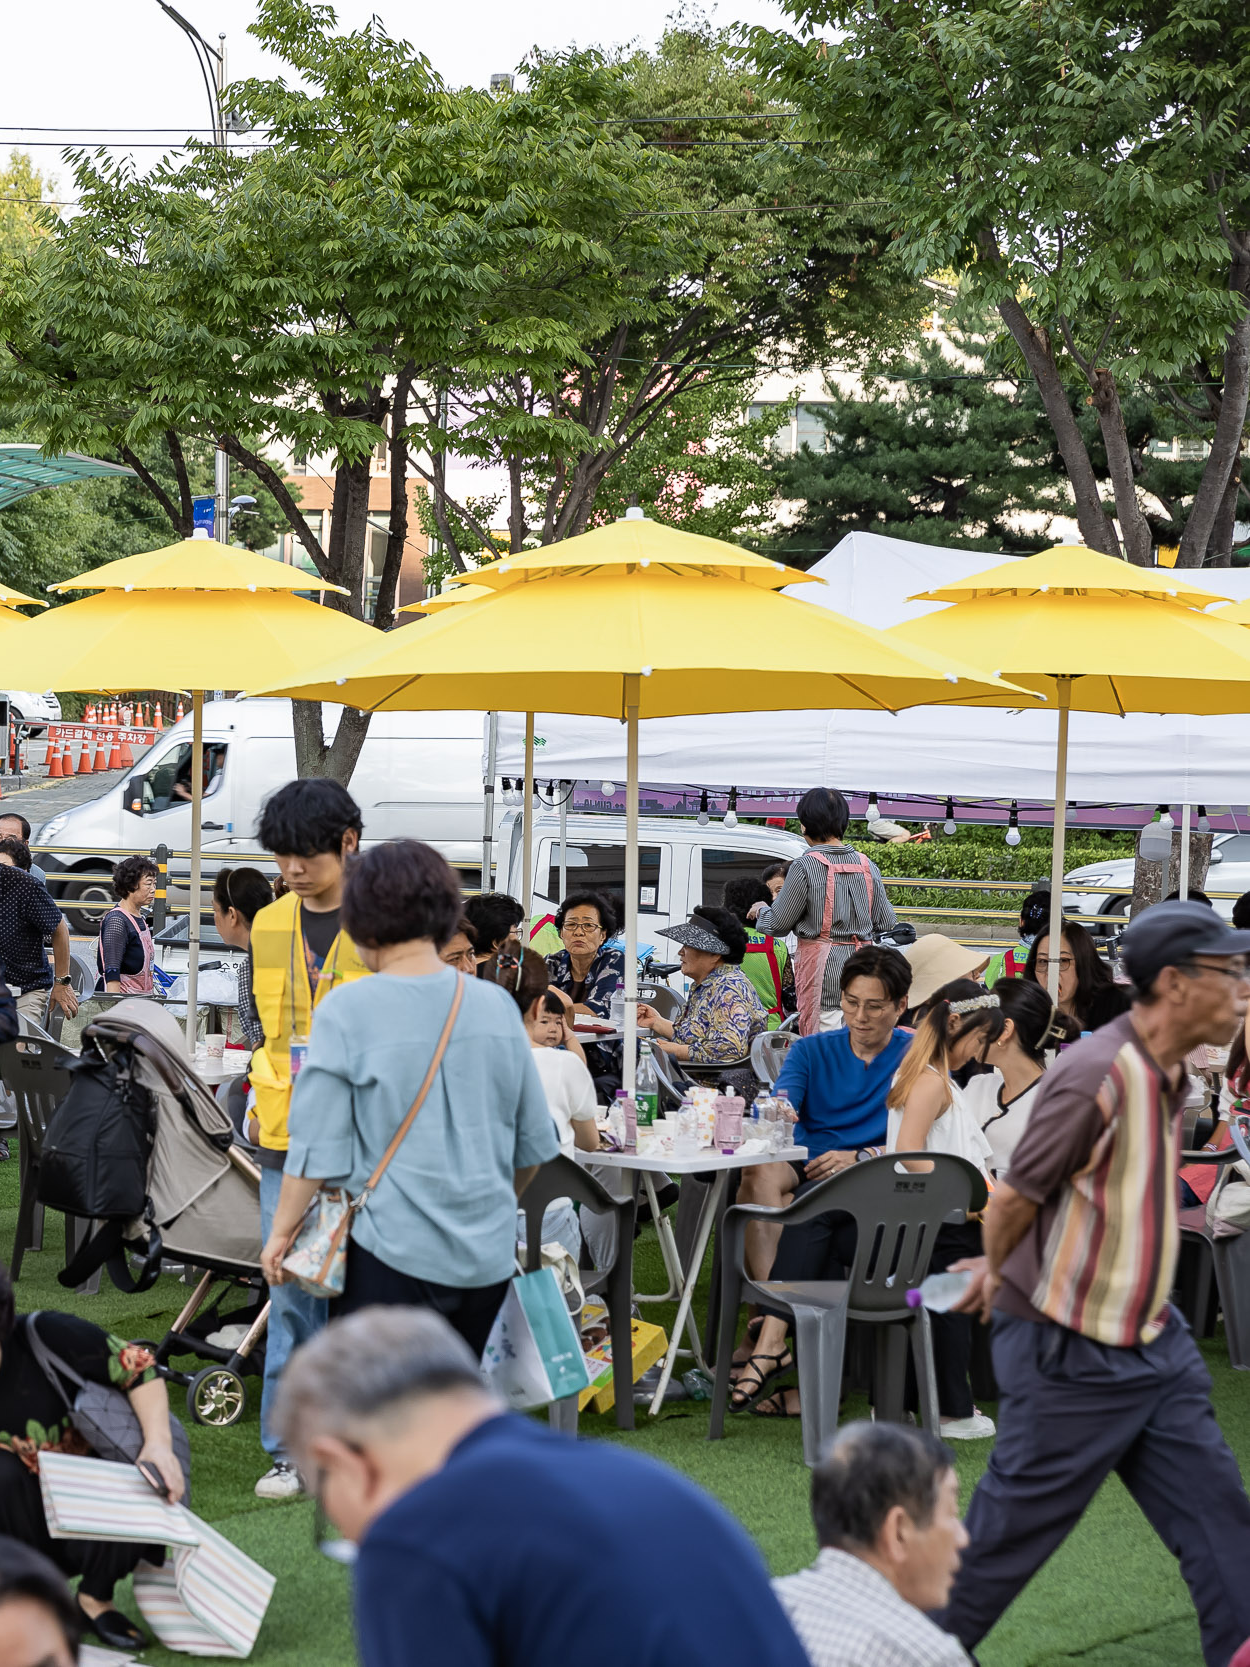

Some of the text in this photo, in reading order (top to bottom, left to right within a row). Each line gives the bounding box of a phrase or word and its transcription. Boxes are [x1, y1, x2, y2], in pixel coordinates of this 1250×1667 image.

[55, 727, 146, 744] 카드결제 전용 주차장
